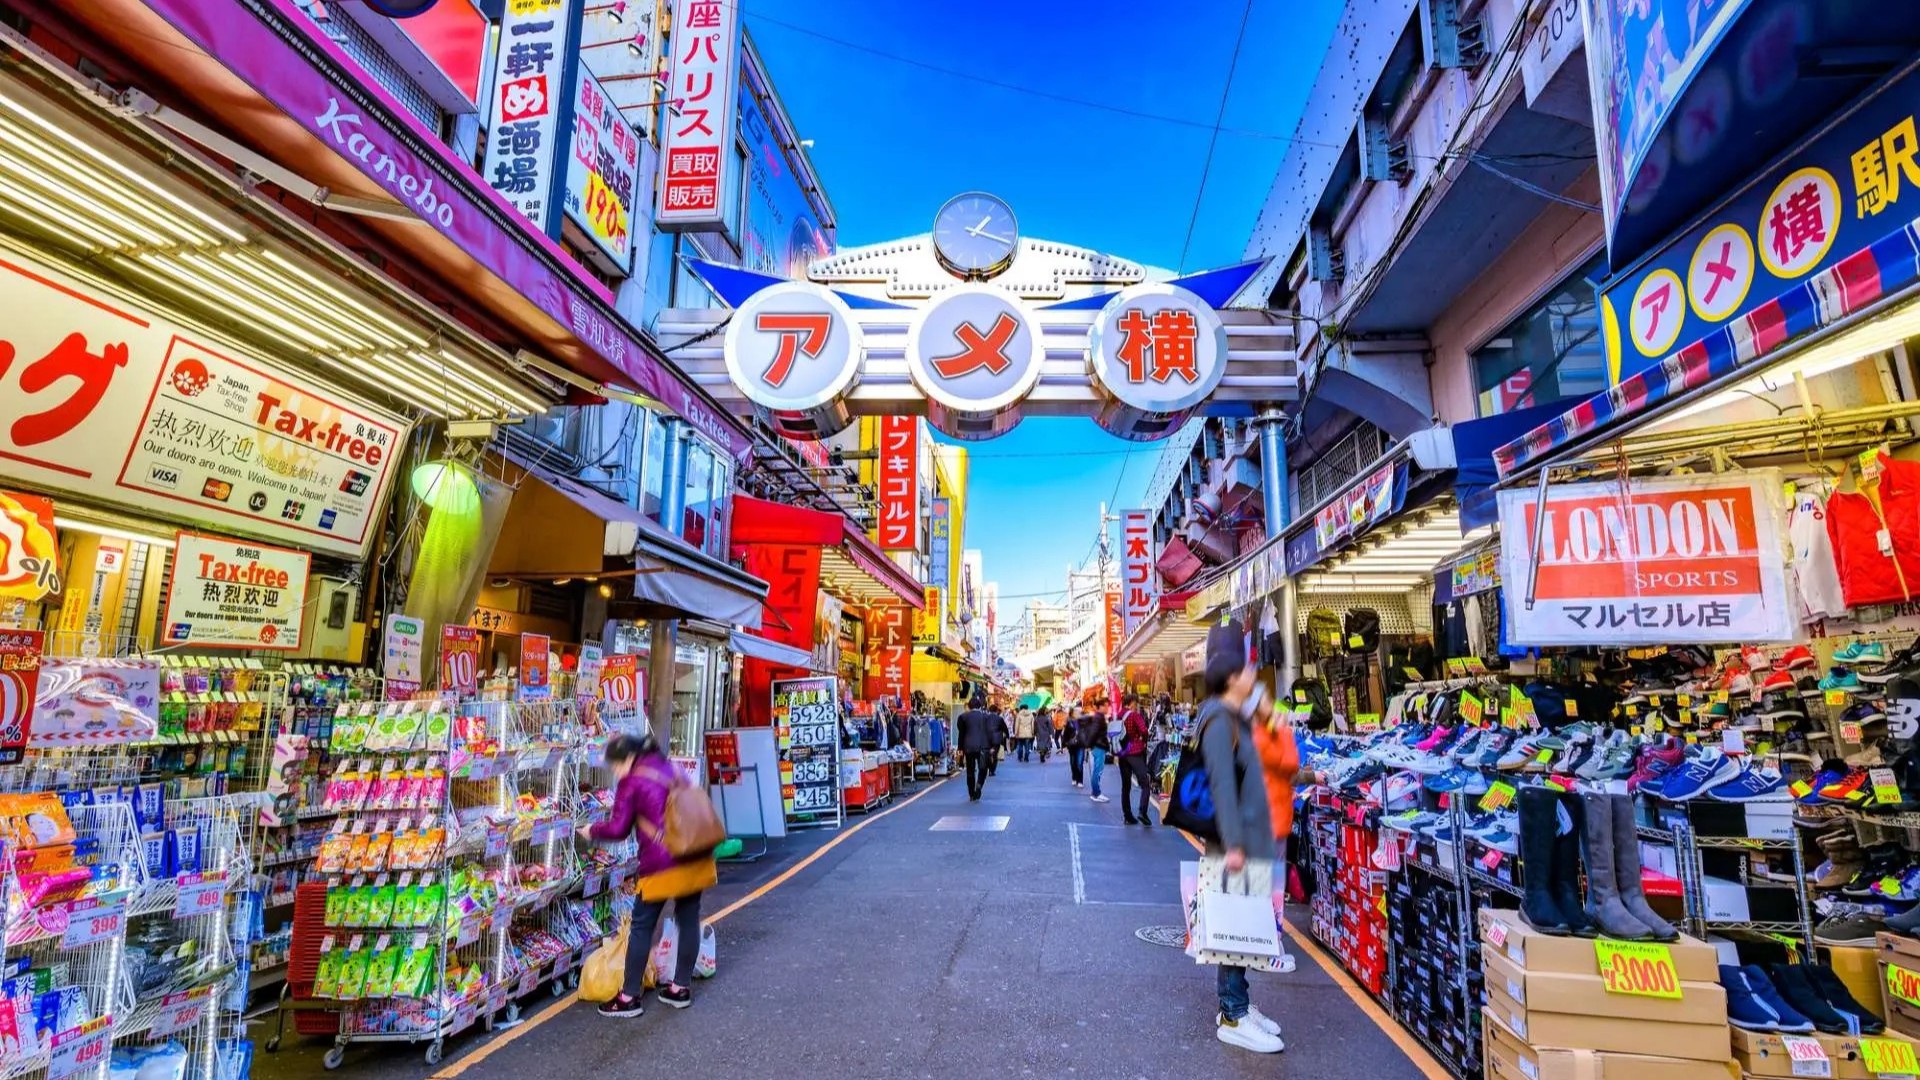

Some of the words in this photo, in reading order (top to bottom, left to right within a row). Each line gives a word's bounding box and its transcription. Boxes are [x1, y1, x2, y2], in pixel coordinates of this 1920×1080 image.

[677, 0, 722, 137] 座パリス
[491, 20, 555, 195] 一軒め酒場
[314, 97, 455, 229] Kanebo
[670, 152, 717, 175] 買取
[667, 185, 715, 207] 販売
[585, 175, 627, 253] 190円
[571, 301, 626, 364] 雪肌精
[0, 332, 129, 447] グ
[216, 384, 248, 404] Tax-free
[223, 399, 246, 415] Shop
[682, 391, 731, 448] Tax-free
[149, 408, 255, 463] 热烈欢迎
[257, 392, 383, 467] Tax-free
[144, 439, 163, 455] Our
[167, 449, 197, 465] doors
[199, 457, 216, 470] are
[218, 461, 243, 479] open.
[248, 470, 287, 492] Welcome
[289, 483, 298, 494] to
[299, 487, 327, 503] Japan!
[151, 468, 178, 484] VISA
[886, 415, 911, 544] トブキゴルフ
[1538, 498, 1740, 564] LONDON
[236, 546, 261, 560] 免税店
[198, 553, 289, 588] Tax-free
[1634, 569, 1739, 590] SPORTS
[203, 581, 280, 608] 热烈欢迎
[1562, 600, 1731, 629] マルセル店
[921, 633, 935, 641] 入口
[448, 650, 475, 688] 10
[601, 675, 632, 704] 10
[790, 703, 837, 724] 5923
[795, 762, 827, 781] 386
[796, 786, 829, 807] 345
[91, 914, 119, 935] 398
[75, 1039, 103, 1064] 498
